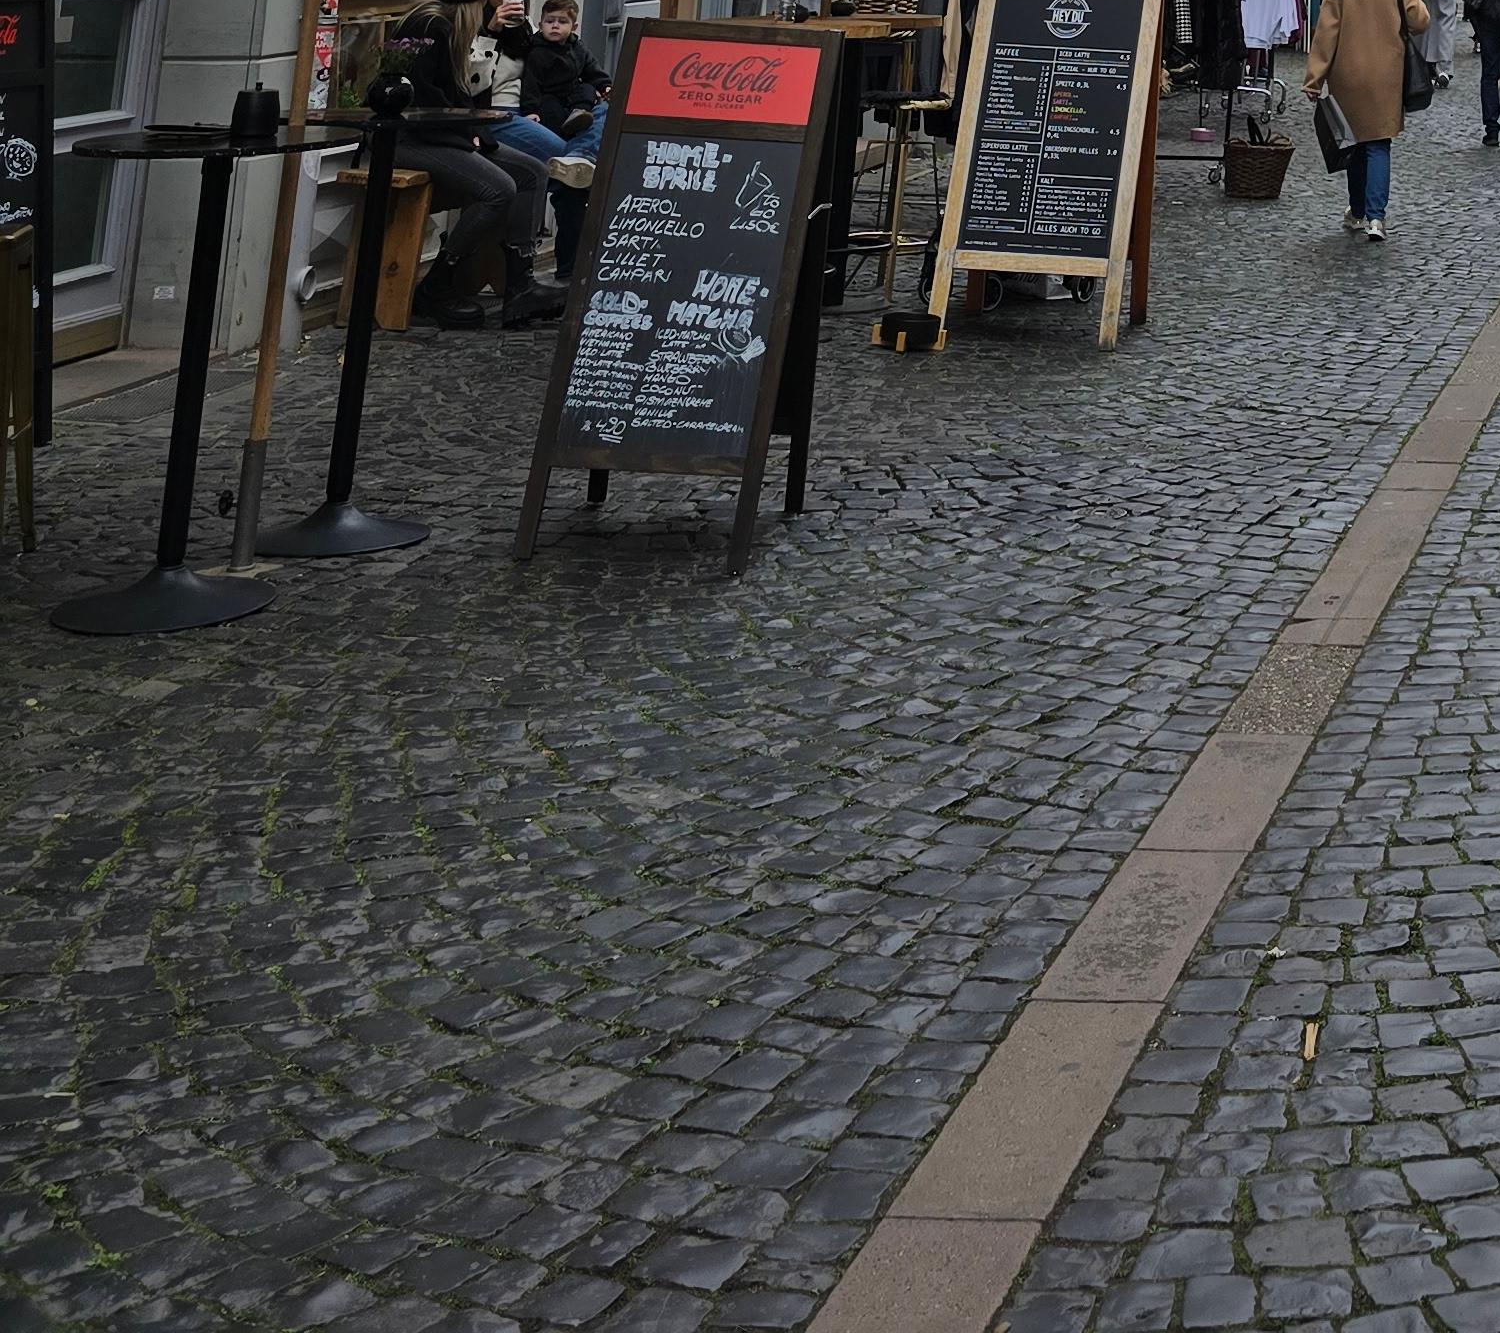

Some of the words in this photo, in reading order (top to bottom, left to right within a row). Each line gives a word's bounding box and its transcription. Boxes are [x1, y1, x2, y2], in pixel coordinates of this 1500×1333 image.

[1051, 9, 1071, 23] HEY
[1071, 10, 1085, 23] DU
[995, 48, 1020, 57] KAFFEE
[1074, 51, 1091, 59] LATTE
[669, 52, 789, 94] Coca-Cola
[678, 90, 713, 102] ZERO
[717, 92, 762, 105] SUGAR
[693, 101, 712, 109] NULL
[714, 102, 744, 110] ZUCKER
[980, 142, 1010, 150] SUPERFOOD
[1078, 146, 1099, 155] HELLES
[616, 194, 682, 218] APEROL
[762, 191, 780, 208] to
[608, 215, 705, 239] LIMONCELLO
[1036, 224, 1058, 233] ALLES
[1060, 225, 1078, 234] AUCH
[1080, 226, 1089, 235] TO
[1091, 227, 1102, 235] GO
[599, 251, 667, 268] LILLET
[597, 267, 673, 283] CAMPARI
[666, 300, 754, 331] MATCHA
[642, 373, 692, 386] MANGO
